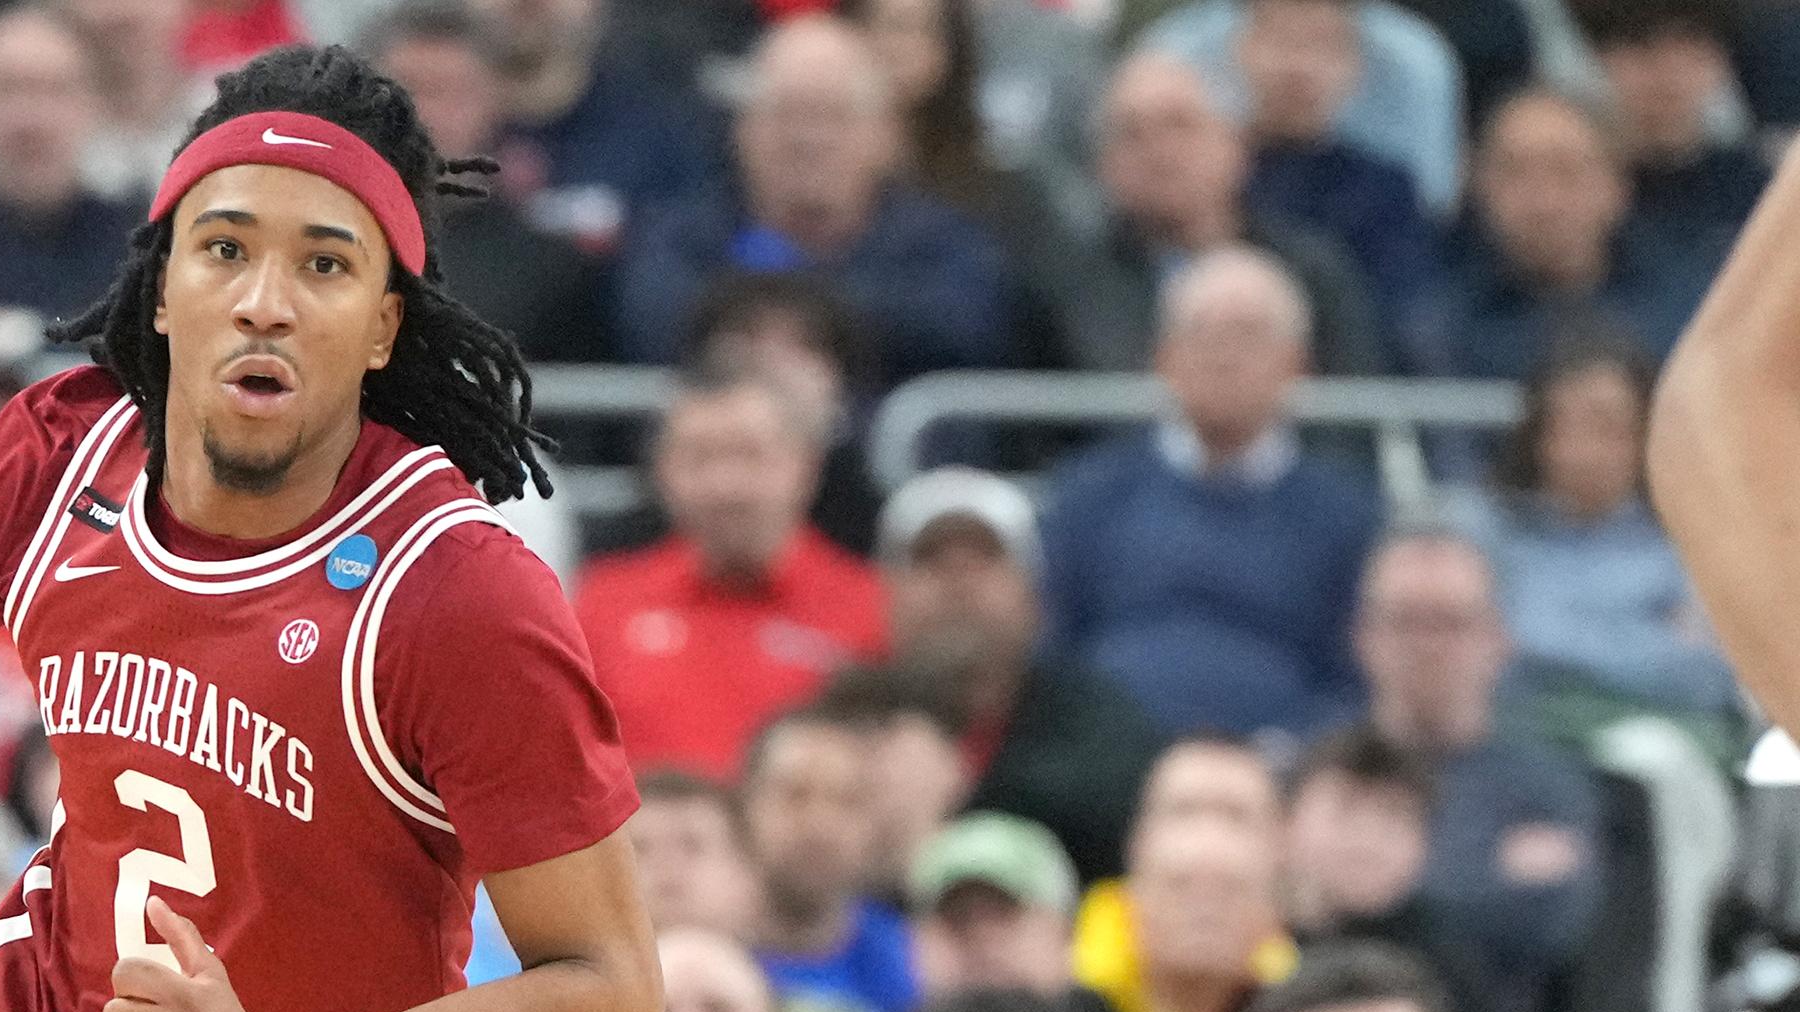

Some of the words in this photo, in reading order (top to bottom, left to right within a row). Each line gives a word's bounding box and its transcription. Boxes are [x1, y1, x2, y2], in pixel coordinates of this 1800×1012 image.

[331, 556, 371, 579] NCAA
[280, 621, 317, 661] SEC
[39, 650, 314, 823] RAZORBACKS
[113, 768, 217, 975] 2
